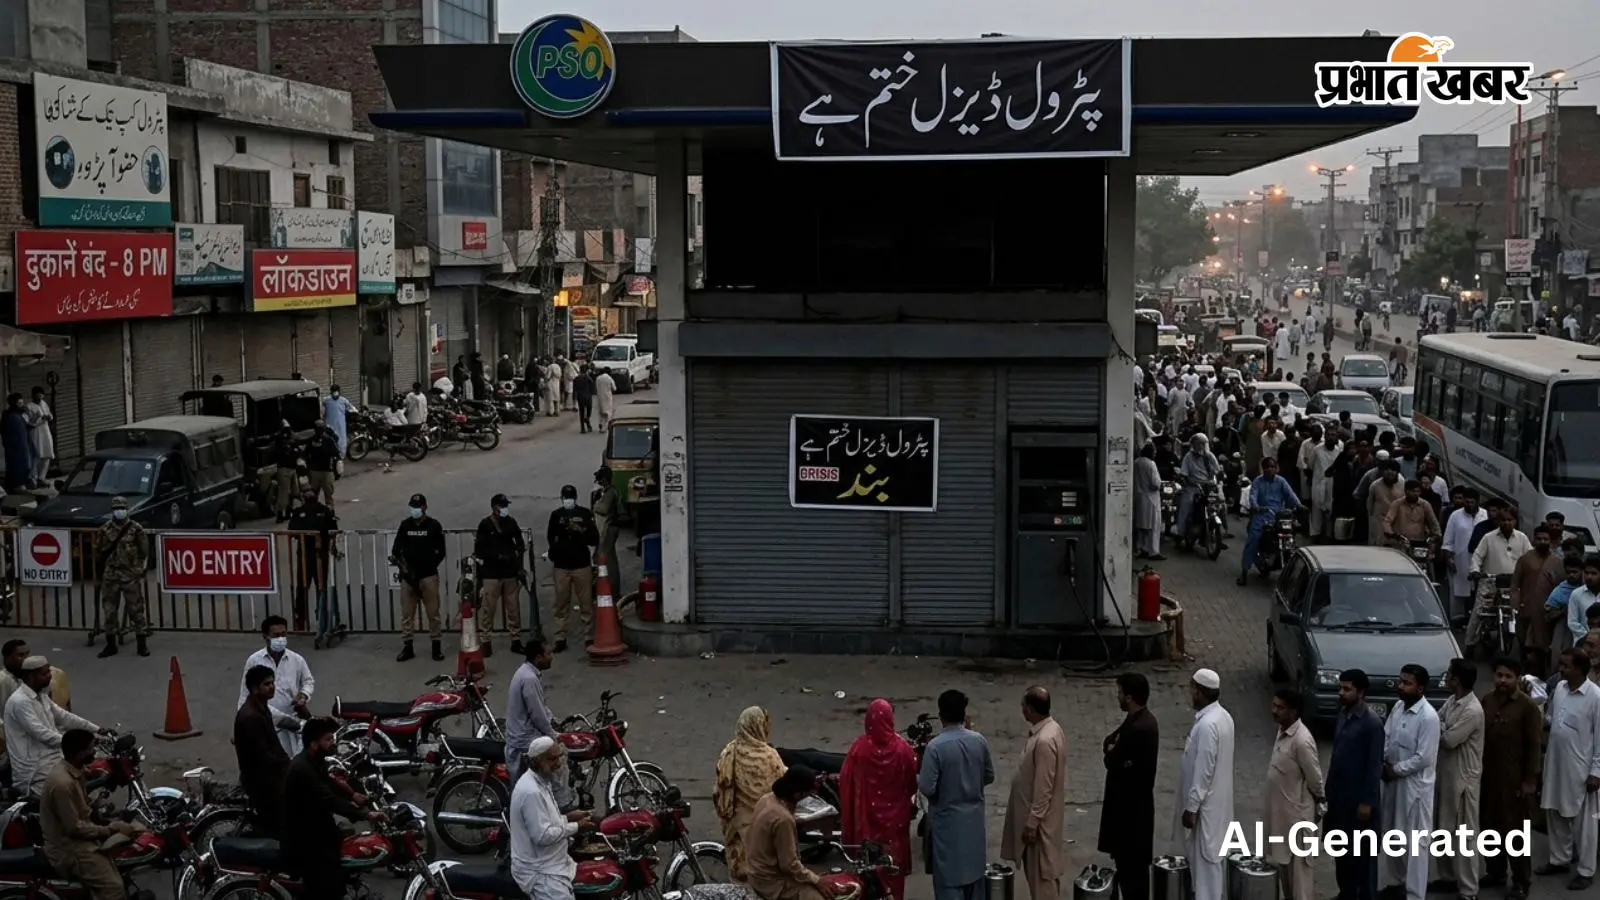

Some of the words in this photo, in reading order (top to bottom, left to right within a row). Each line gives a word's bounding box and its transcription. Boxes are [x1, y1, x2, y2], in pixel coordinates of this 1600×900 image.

[536, 42, 604, 79] PSO
[864, 51, 918, 148] ختم
[910, 63, 1002, 135] ڈیزل
[1005, 60, 1103, 134] پٹرول
[798, 93, 859, 147] ہے
[24, 238, 78, 291] दुकानें
[81, 240, 107, 279] बंद
[123, 247, 134, 277] 8
[139, 247, 168, 277] PM
[259, 255, 353, 294] लॉकडाउन
[799, 438, 824, 461] ہے
[826, 422, 850, 463] ختم
[886, 428, 929, 459] پٹرول
[836, 464, 890, 502] بند
[24, 568, 38, 580] NO
[168, 550, 196, 575] NO
[202, 550, 265, 575] ENTRY
